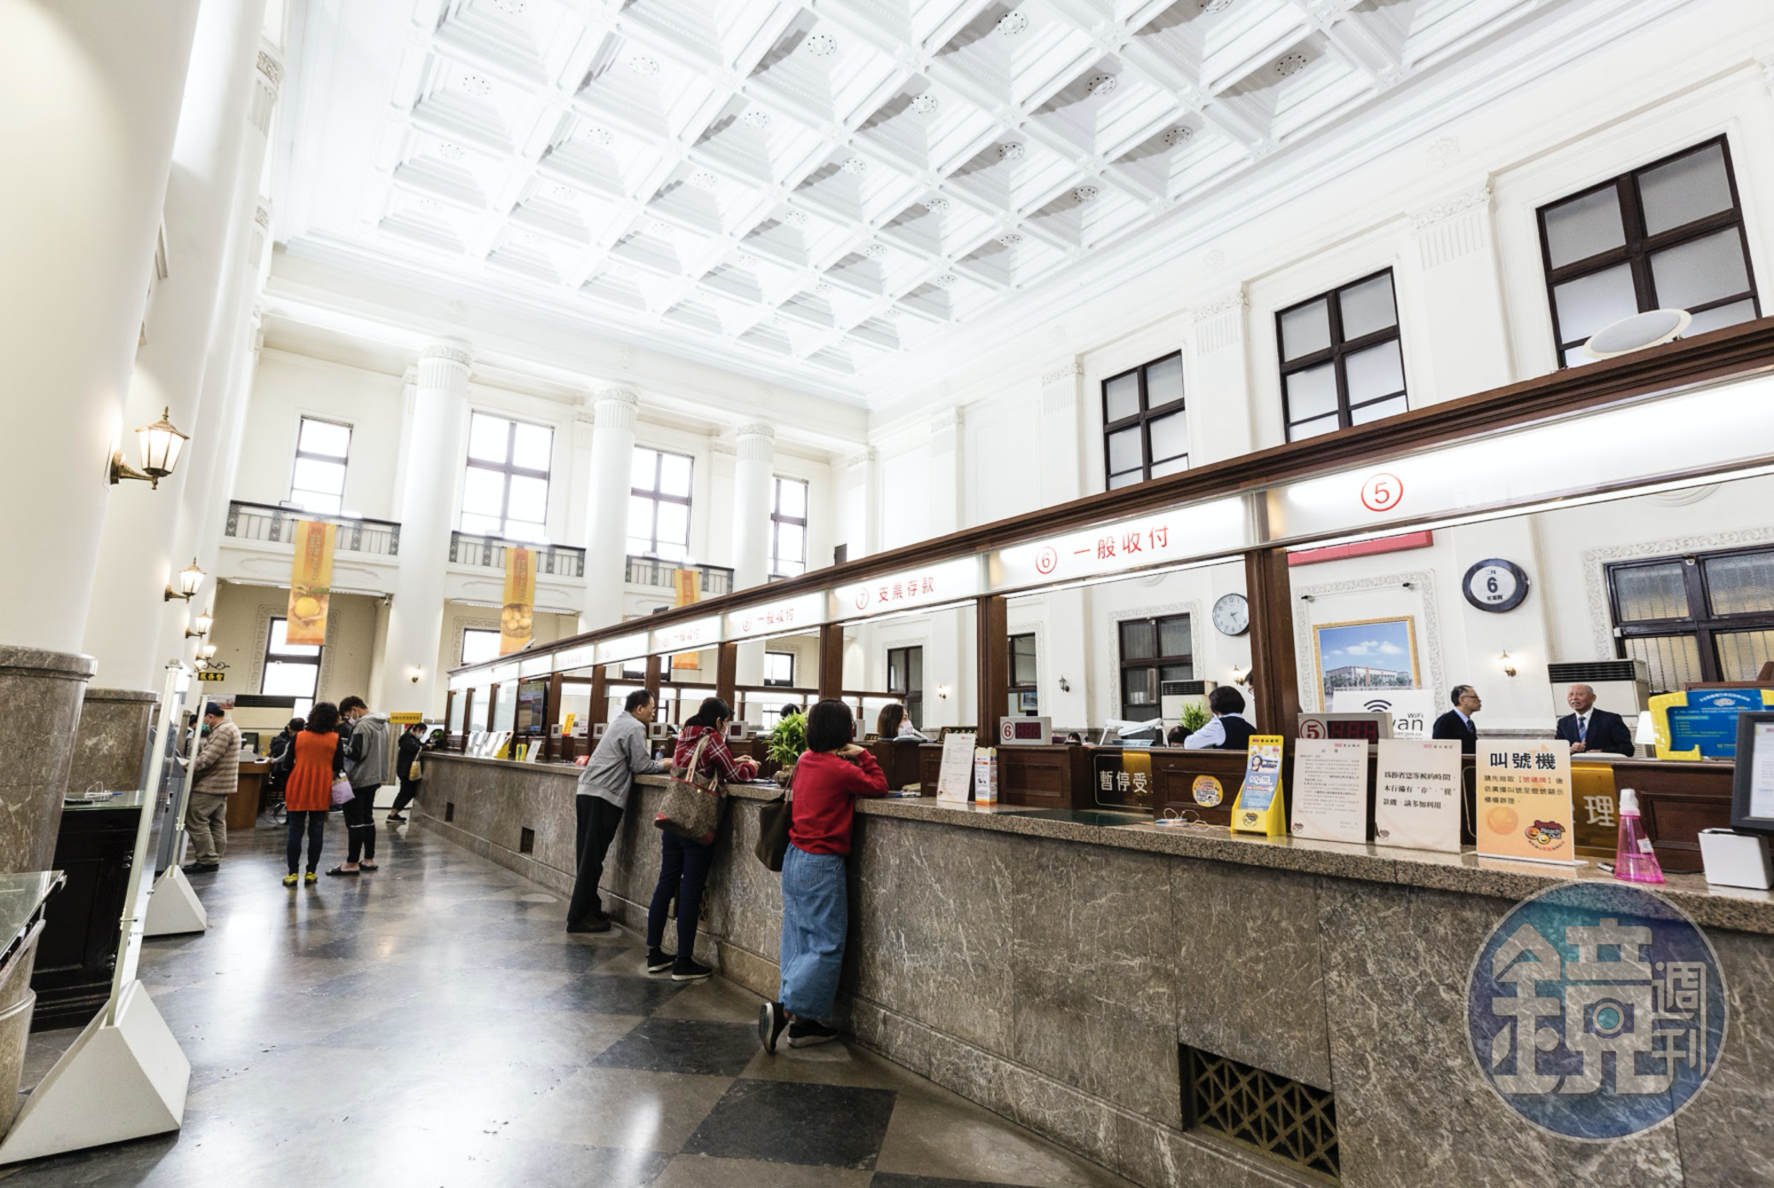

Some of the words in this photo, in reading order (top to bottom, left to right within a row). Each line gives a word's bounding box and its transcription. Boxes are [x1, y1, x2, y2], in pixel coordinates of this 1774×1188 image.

[1073, 525, 1168, 560] 一般收付
[878, 577, 935, 604] 支票存款
[1487, 577, 1498, 593] 6
[1490, 752, 1556, 770] 叫號機
[1100, 770, 1154, 794] 暫停受
[1572, 795, 1616, 827] 理
